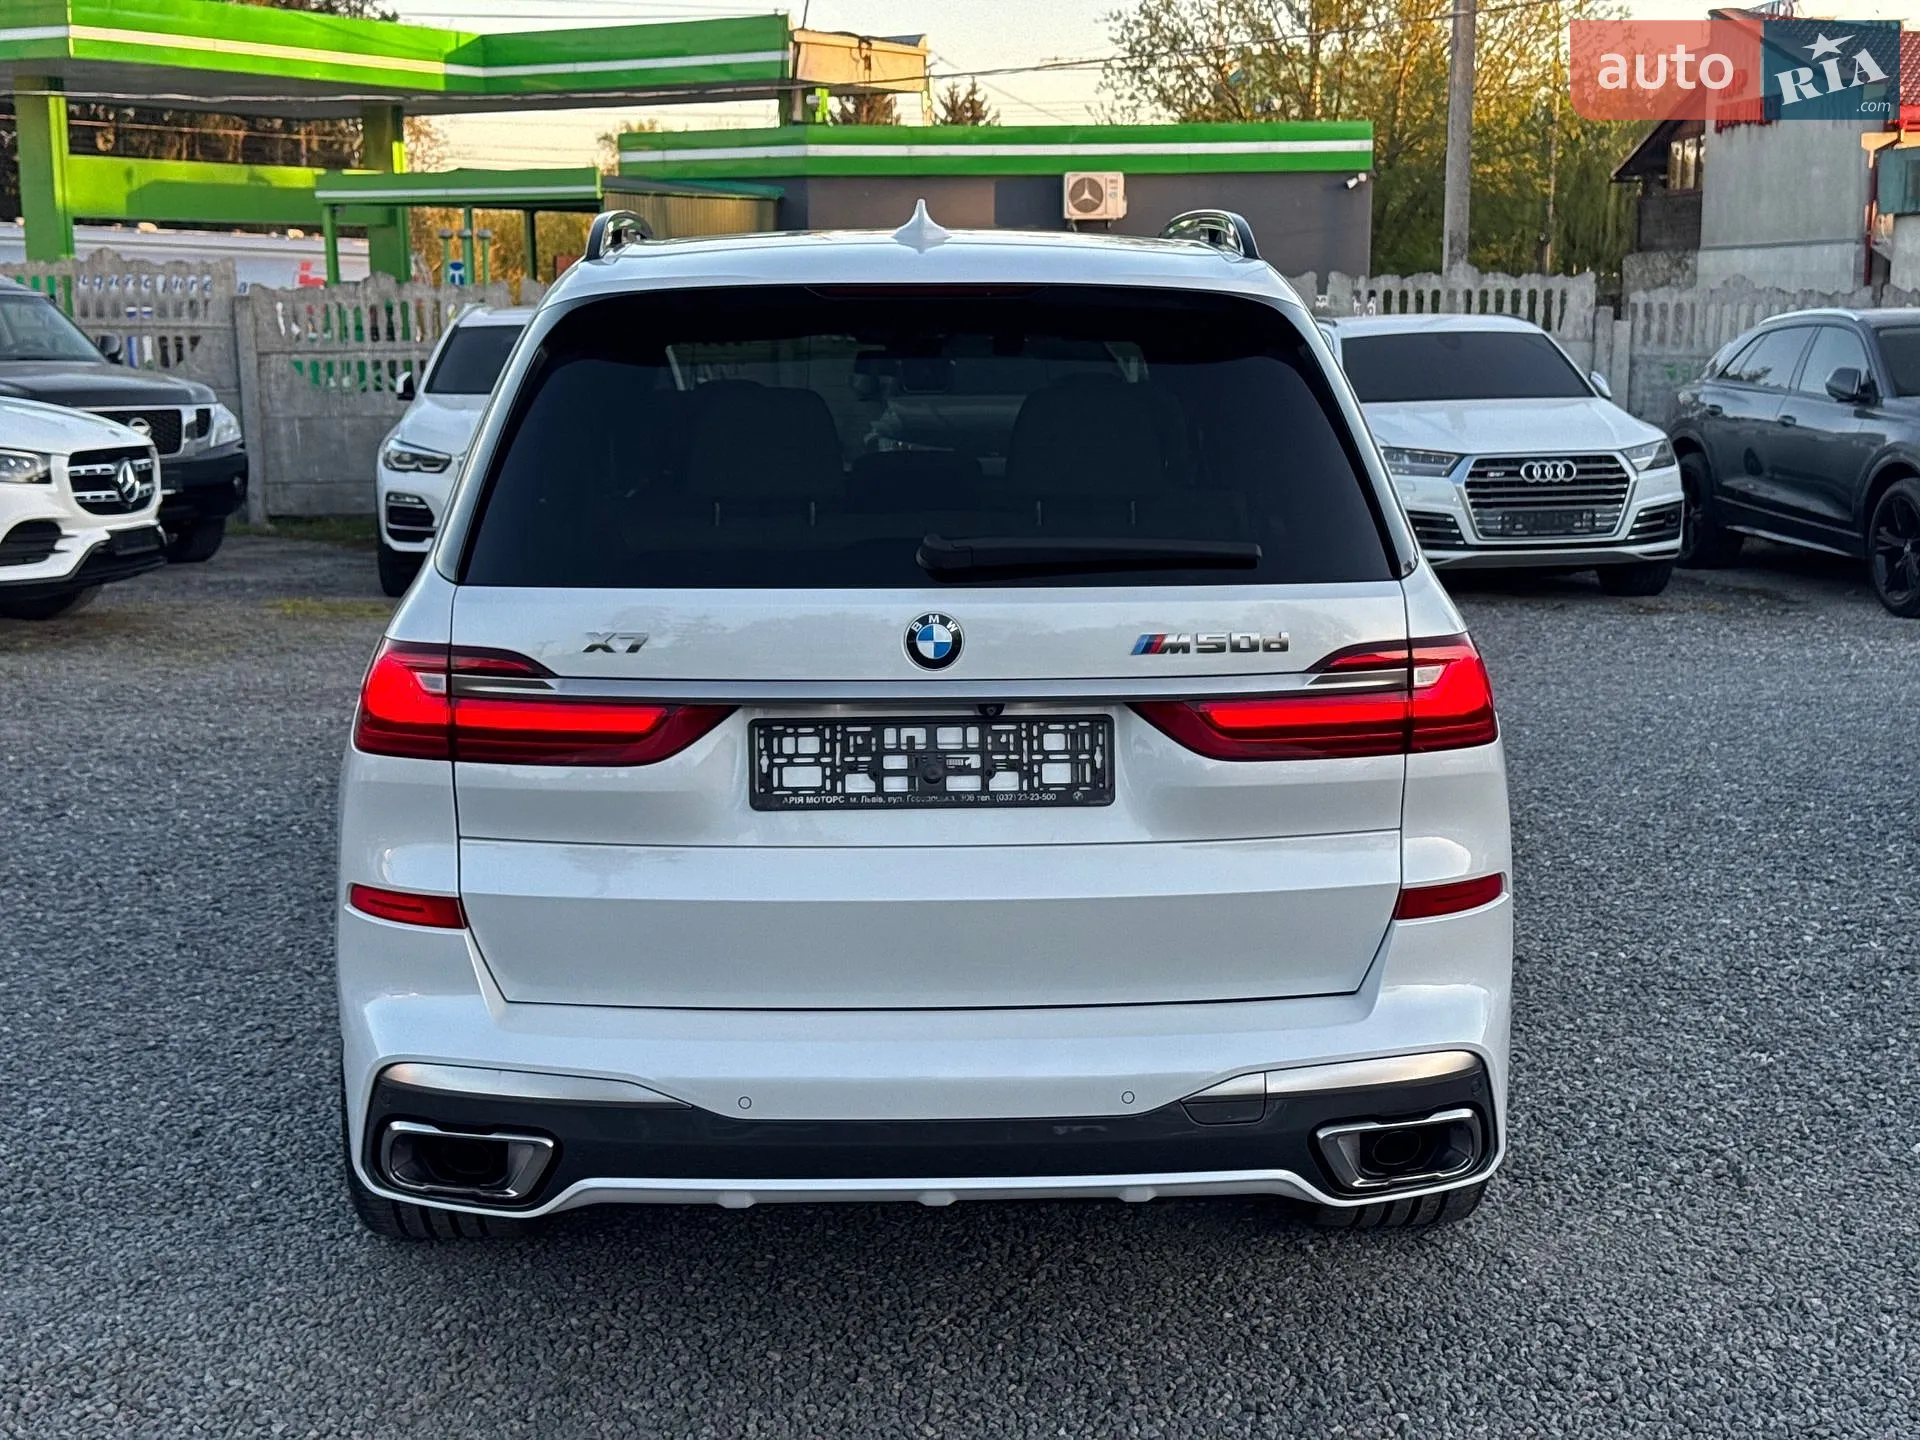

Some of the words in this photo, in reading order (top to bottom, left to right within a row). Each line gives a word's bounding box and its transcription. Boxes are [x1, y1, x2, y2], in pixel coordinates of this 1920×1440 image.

[911, 614, 958, 632] BMW
[583, 632, 648, 653] X7
[806, 796, 845, 804] МОТОРС
